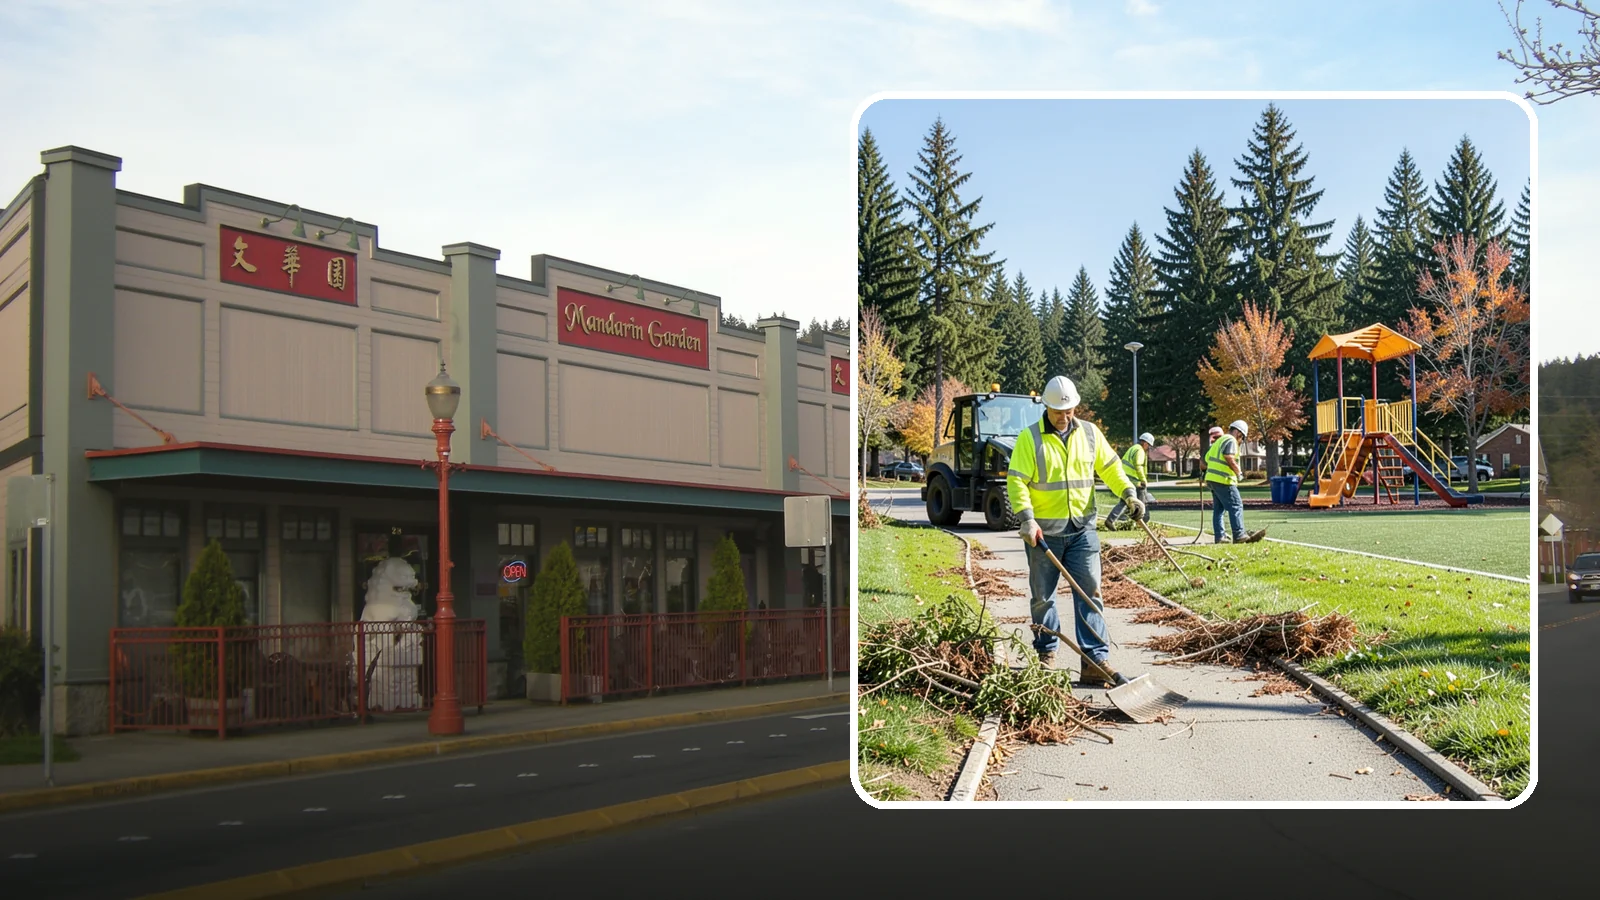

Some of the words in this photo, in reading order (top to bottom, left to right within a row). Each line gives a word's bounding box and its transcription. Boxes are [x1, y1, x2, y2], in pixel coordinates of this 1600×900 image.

[231, 236, 346, 291] 文華園
[564, 302, 644, 341] Mandarin
[648, 320, 701, 352] Garden
[503, 565, 527, 578] OPEN
